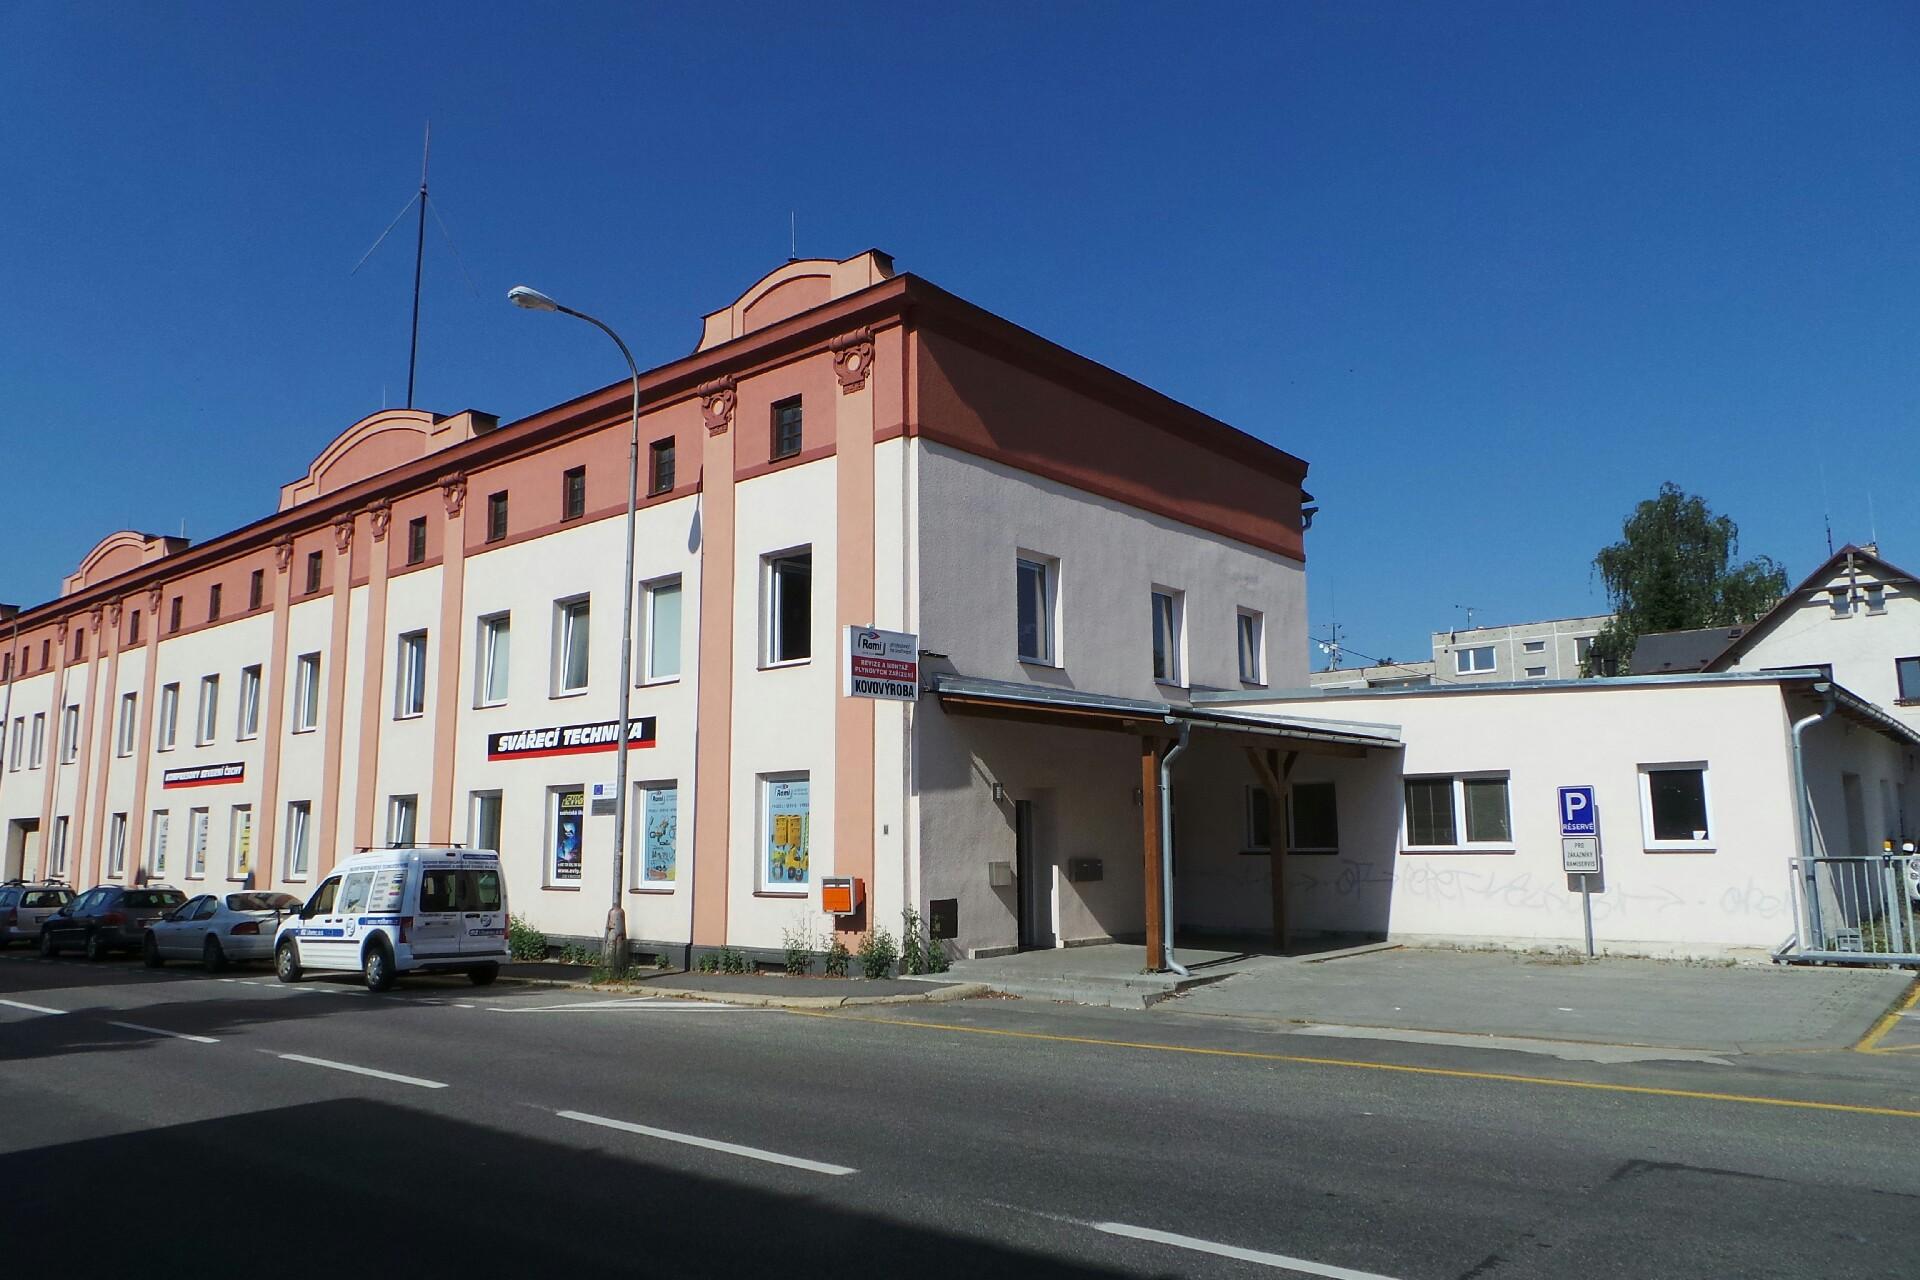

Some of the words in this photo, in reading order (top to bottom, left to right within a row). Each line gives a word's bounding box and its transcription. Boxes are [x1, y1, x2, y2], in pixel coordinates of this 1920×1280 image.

[862, 639, 882, 651] Rami
[860, 659, 881, 668] REVIZE
[855, 679, 915, 697] KOVOVÝROBA
[498, 728, 561, 751] SVÁŘECÍ
[1565, 792, 1587, 821] P
[1562, 822, 1595, 831] RÉSERVÉ
